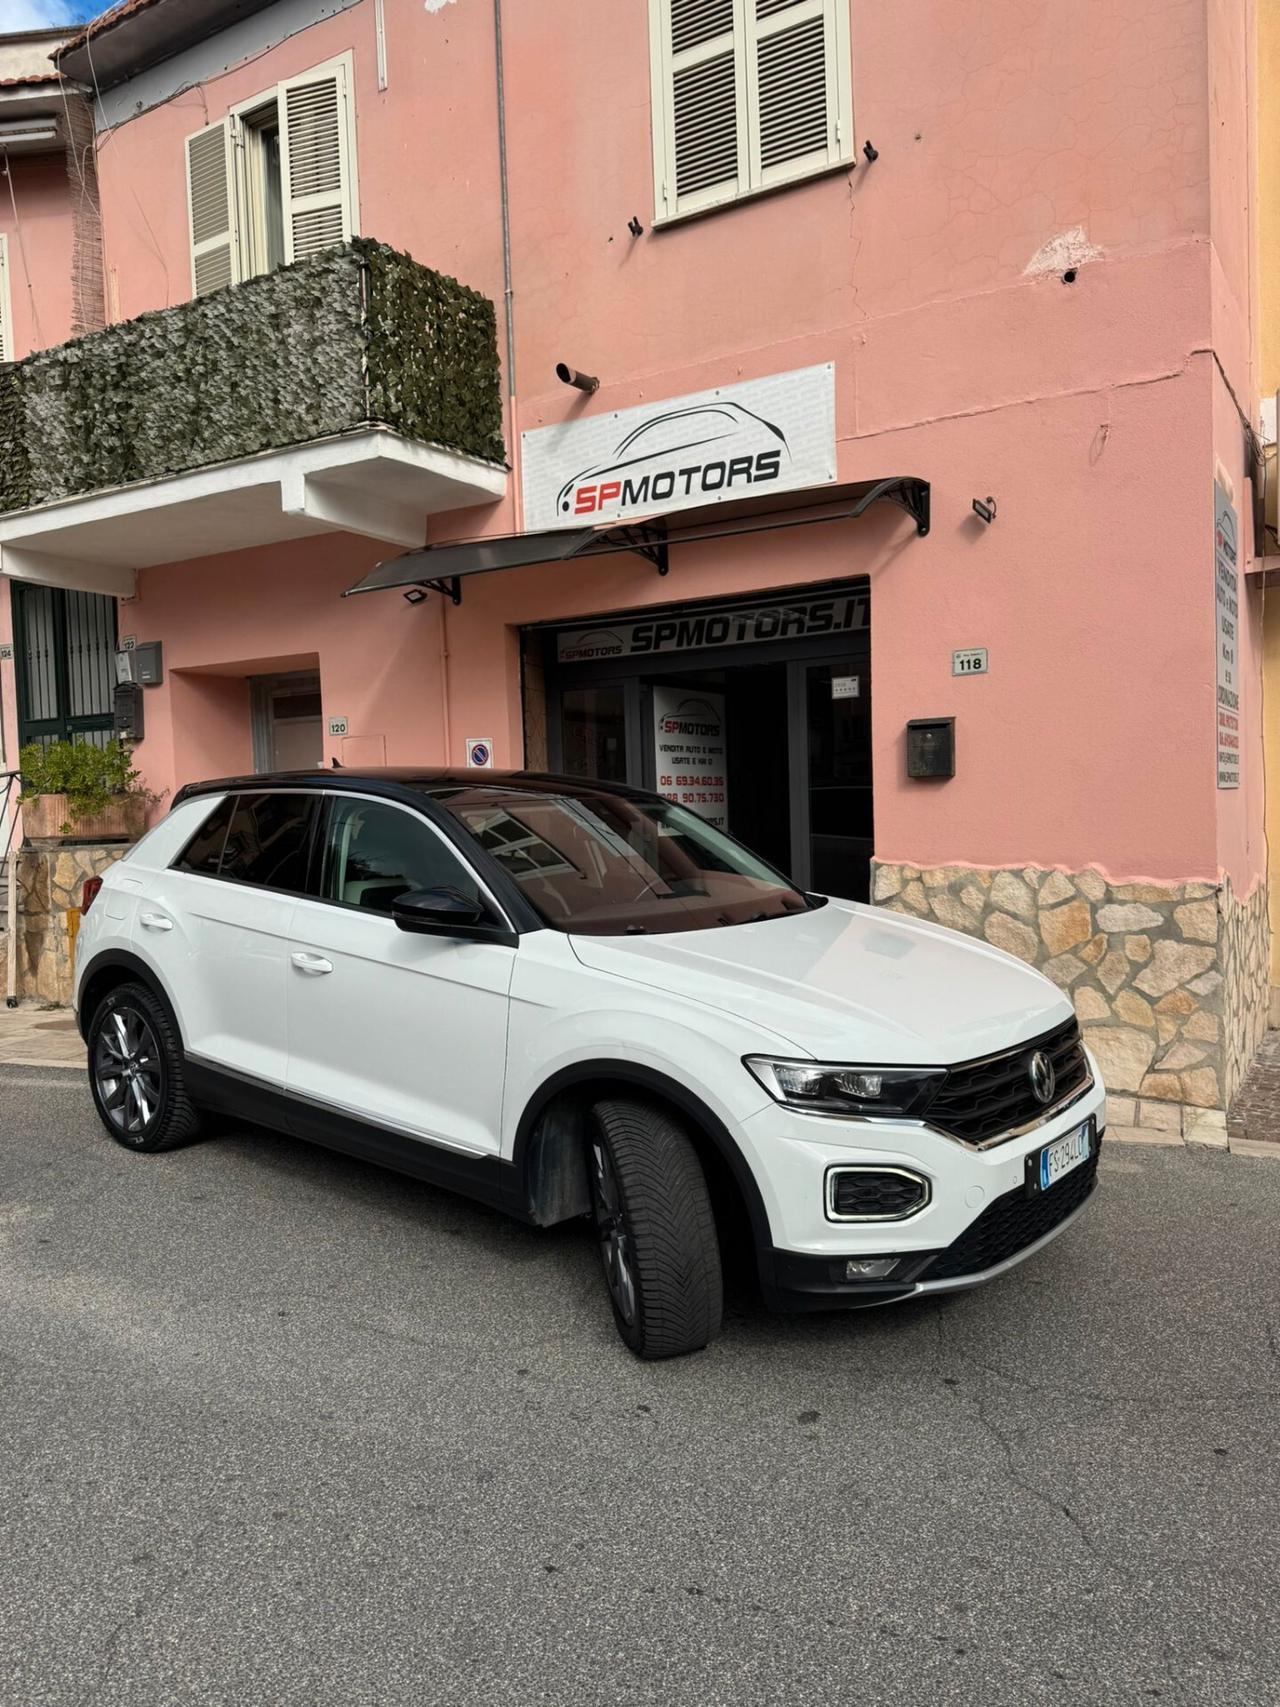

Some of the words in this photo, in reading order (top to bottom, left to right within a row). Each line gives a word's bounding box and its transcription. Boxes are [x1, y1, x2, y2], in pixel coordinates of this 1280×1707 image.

[574, 450, 781, 515] SPMOTORS
[959, 658, 982, 671] 118
[332, 724, 345, 733] 120
[664, 720, 720, 737] SPMOTORS
[660, 775, 672, 786] 06
